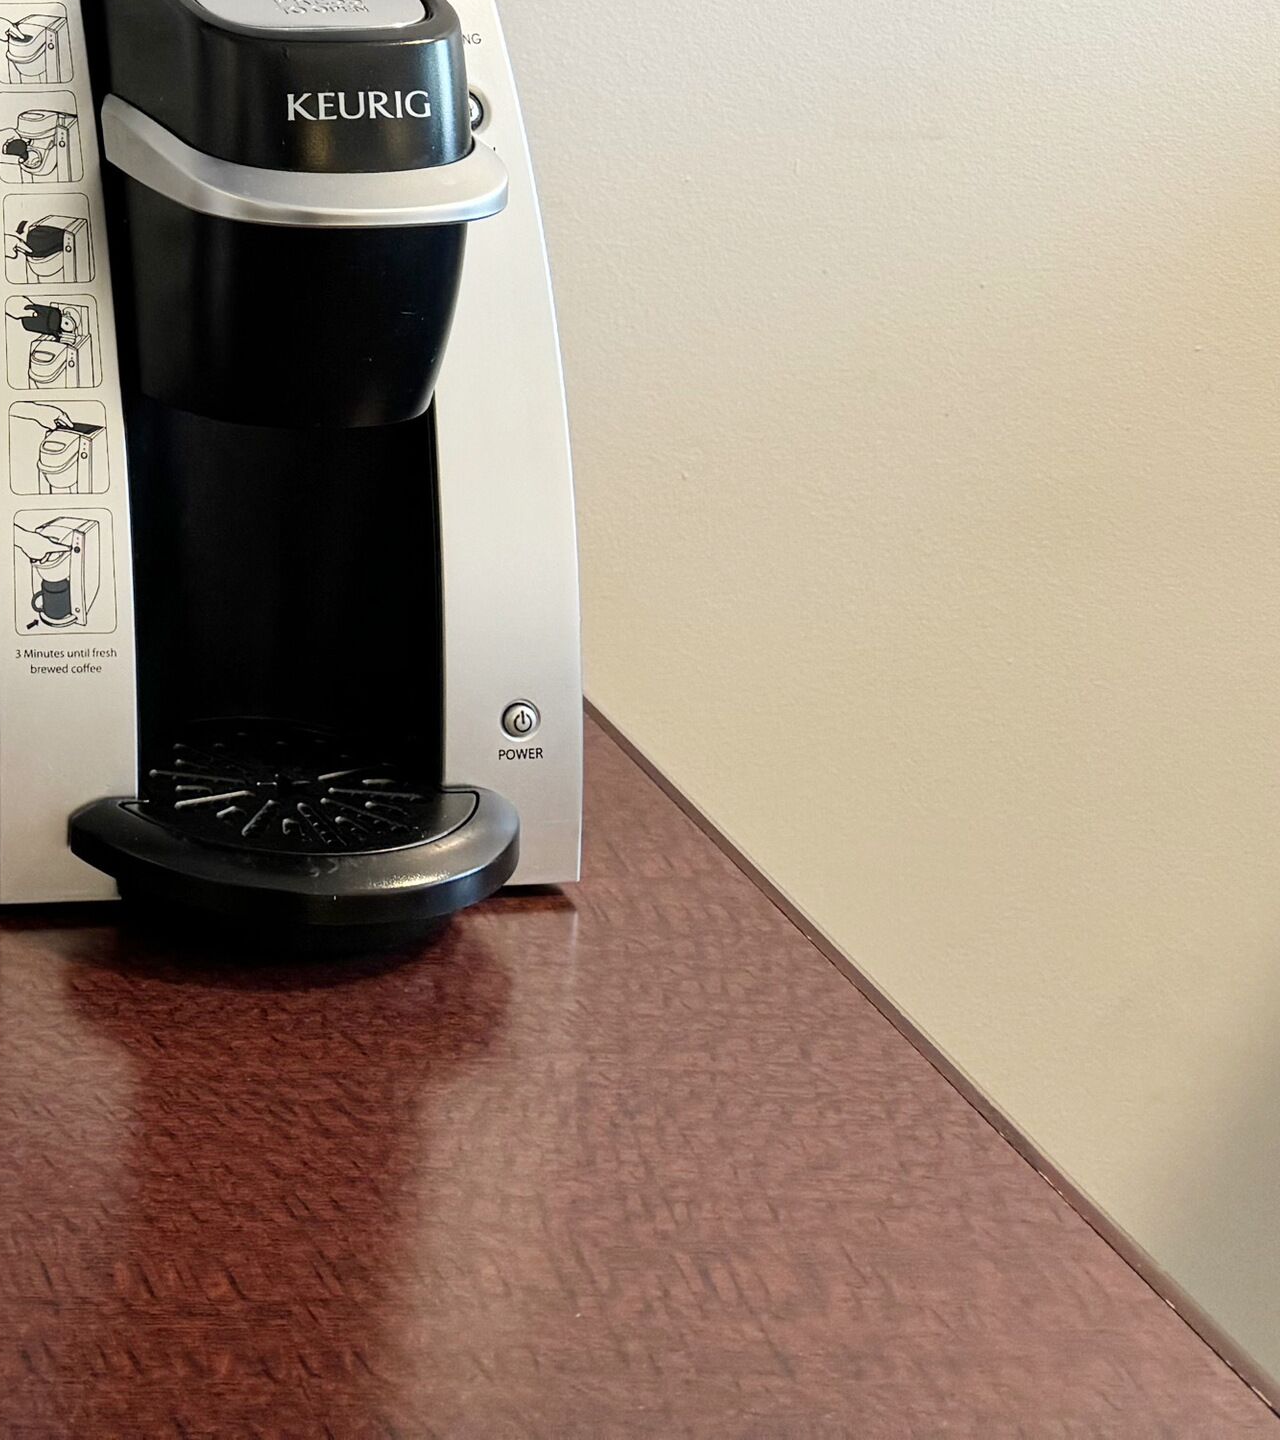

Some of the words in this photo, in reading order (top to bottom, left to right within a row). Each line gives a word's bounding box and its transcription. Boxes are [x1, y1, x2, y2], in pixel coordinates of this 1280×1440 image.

[287, 91, 432, 121] KEURIG
[16, 649, 21, 659] 3
[24, 648, 64, 658] Minutes
[67, 648, 90, 658] until
[92, 647, 117, 658] fresh
[30, 664, 68, 674] brewed
[71, 663, 102, 673] coffee
[498, 747, 543, 760] POWER
